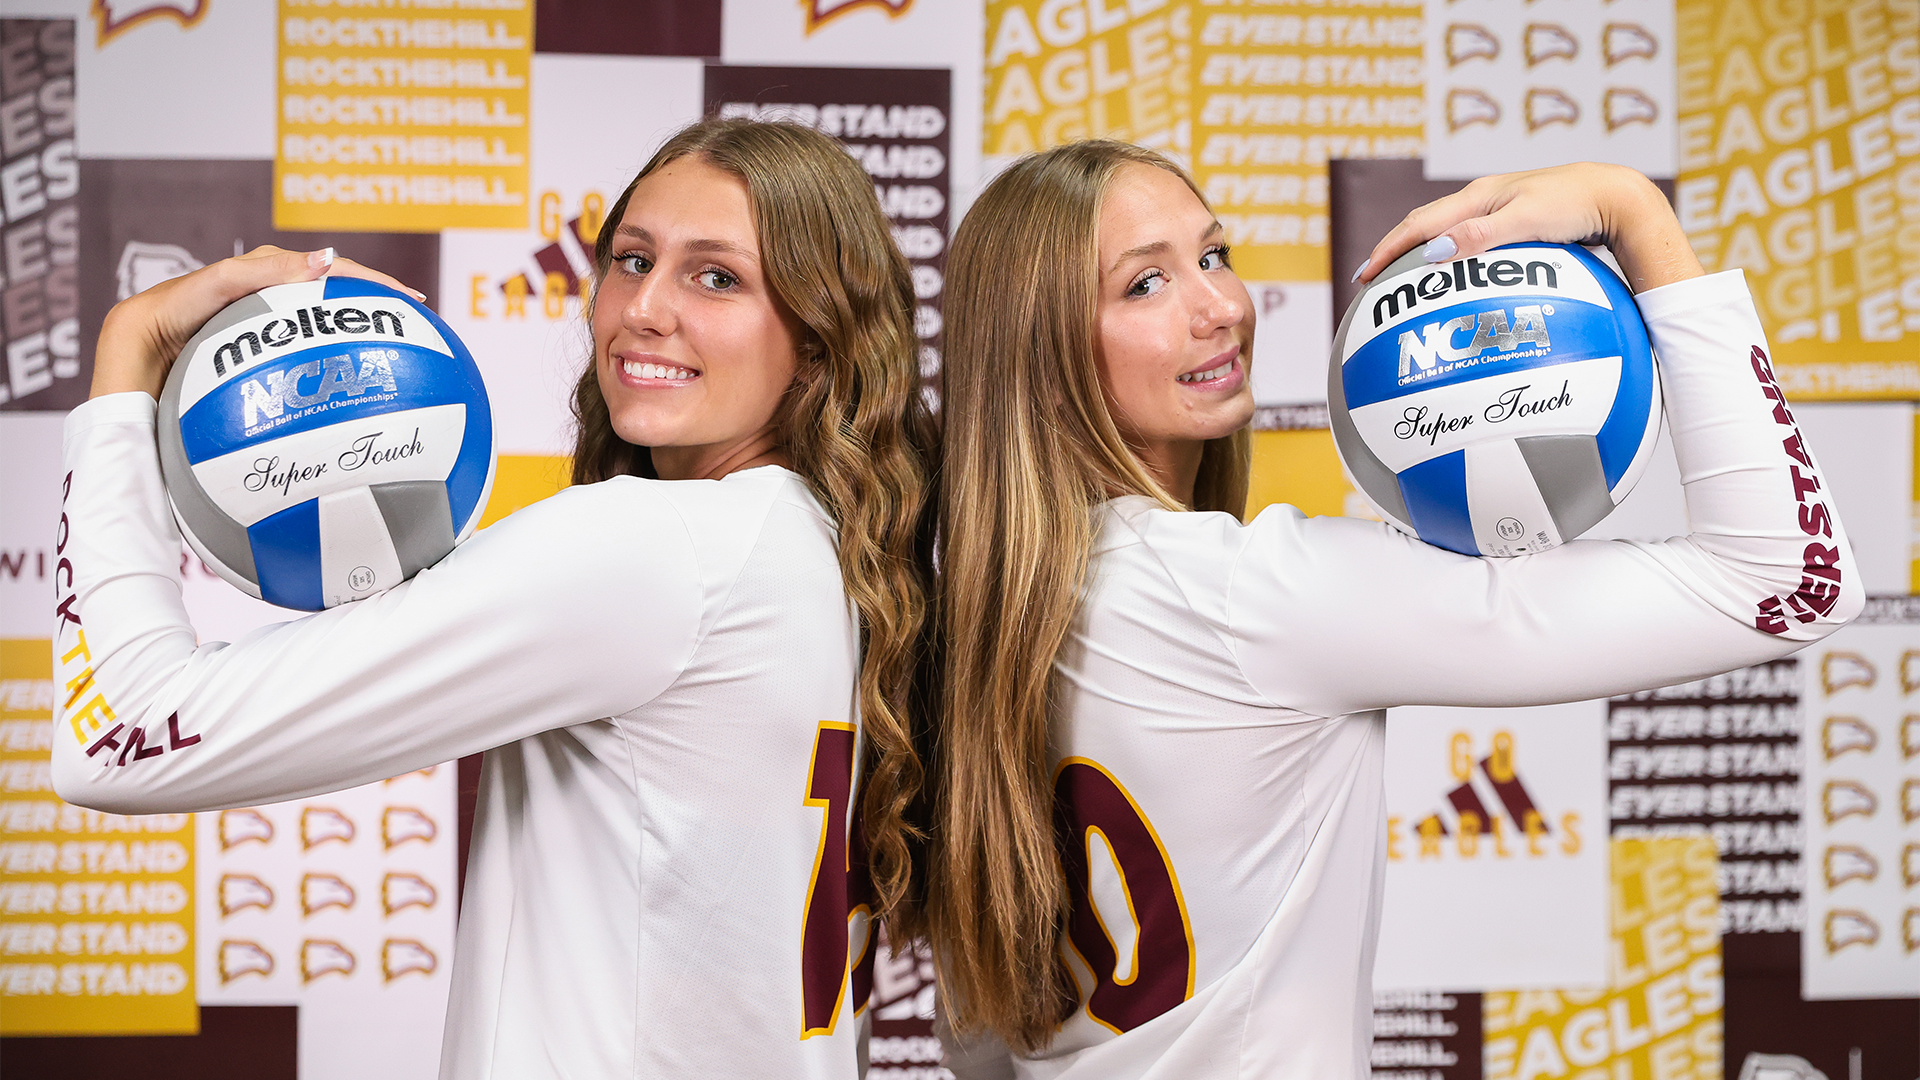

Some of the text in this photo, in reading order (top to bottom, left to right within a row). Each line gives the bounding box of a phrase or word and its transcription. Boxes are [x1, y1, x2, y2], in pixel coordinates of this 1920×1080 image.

[1394, 379, 1573, 446] Super Touch
[243, 427, 424, 497] Super Touch
[1448, 731, 1516, 783] GO
[1388, 808, 1583, 861] EAGLES
